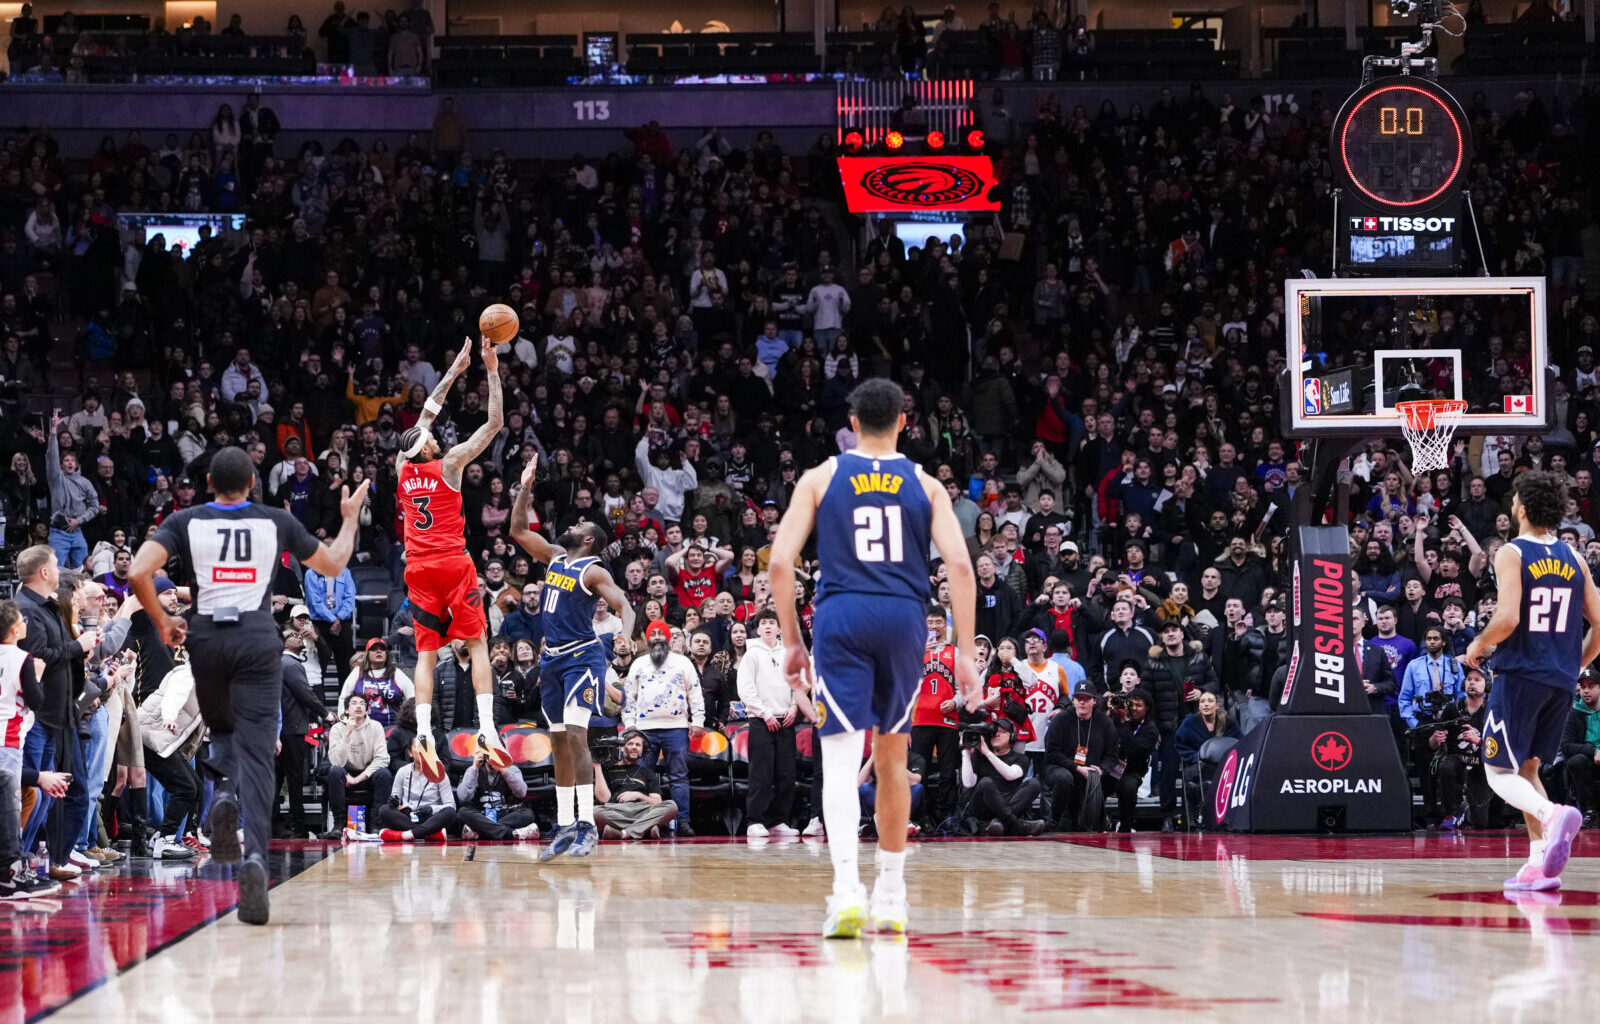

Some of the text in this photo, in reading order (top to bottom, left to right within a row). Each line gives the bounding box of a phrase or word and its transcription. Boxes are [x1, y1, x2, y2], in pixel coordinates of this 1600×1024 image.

[573, 100, 610, 121] 113
[1381, 107, 1423, 135] 0.0
[1379, 216, 1455, 231] TISSOT
[401, 477, 439, 493] INGRAM
[849, 472, 904, 495] JONES
[411, 496, 434, 530] 3
[216, 528, 252, 562] 70
[853, 504, 904, 562] 21
[215, 569, 253, 580] Emirates
[1528, 557, 1576, 581] MURRAY
[543, 587, 560, 614] 10
[1528, 586, 1573, 633] 27
[1312, 558, 1346, 704] POINTSBET
[929, 678, 938, 695] 1
[1029, 697, 1047, 713] 12
[1230, 752, 1255, 809] LG
[1279, 778, 1382, 794] AEROPLAN
